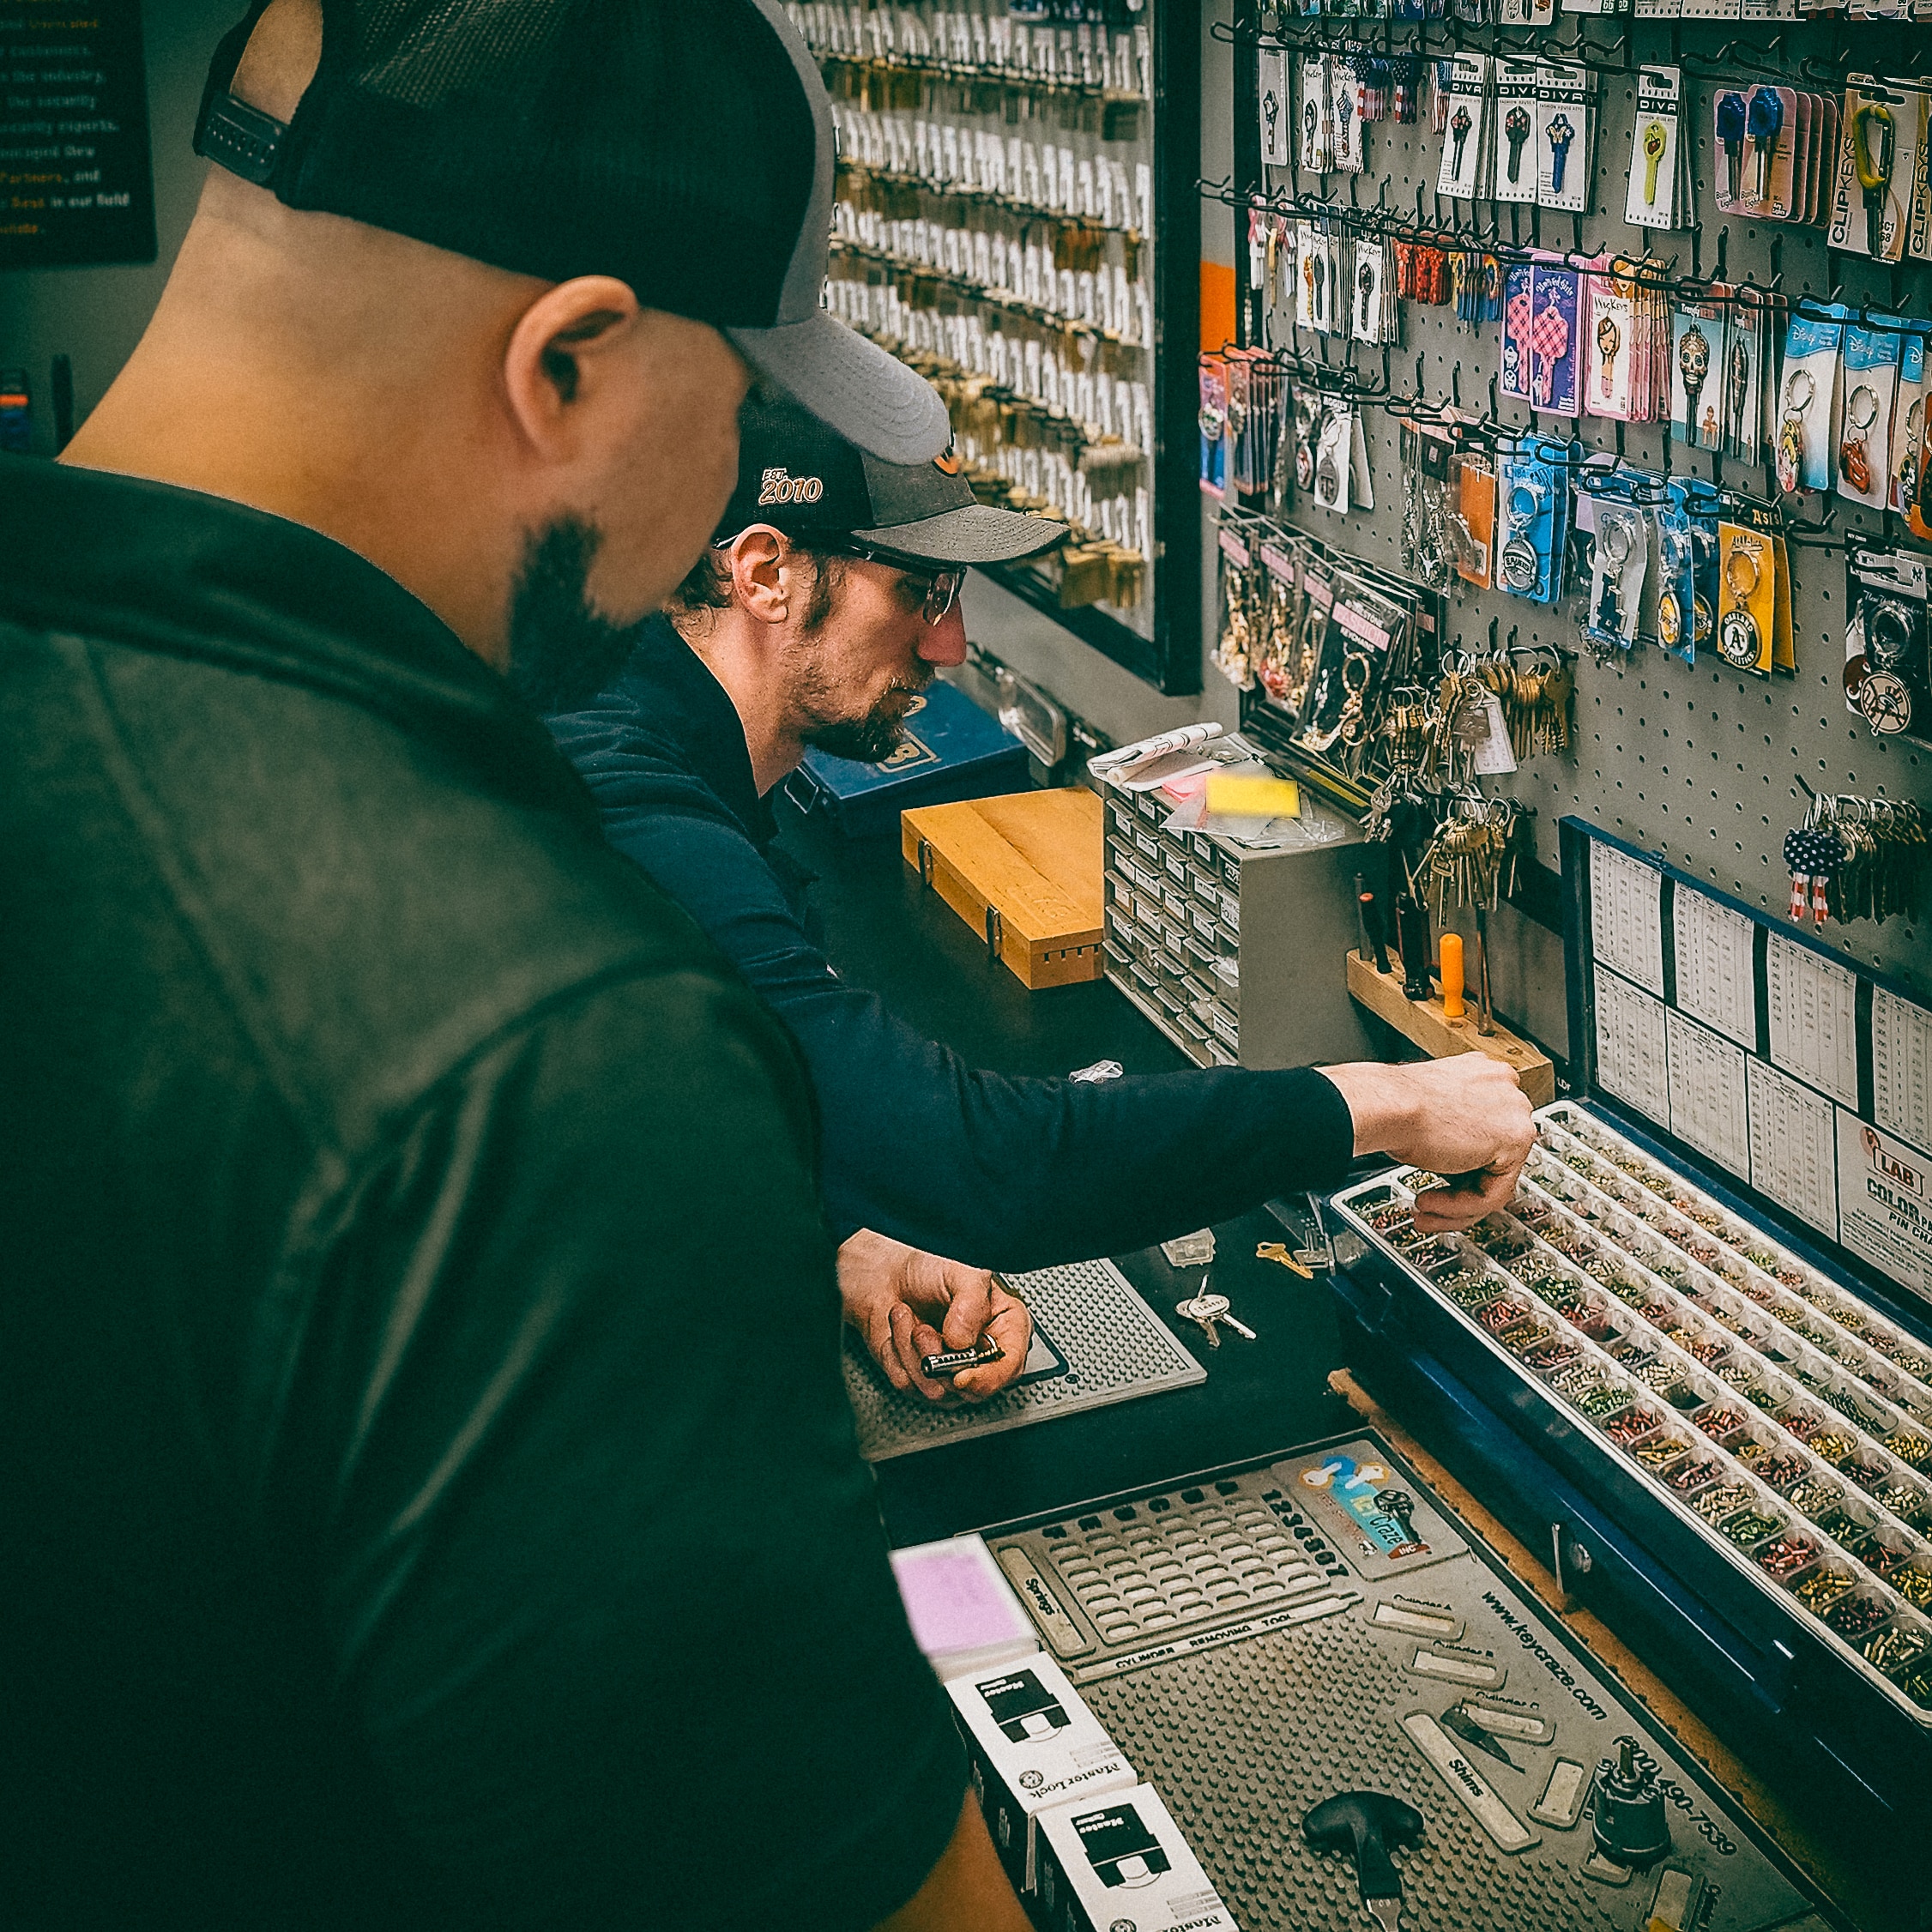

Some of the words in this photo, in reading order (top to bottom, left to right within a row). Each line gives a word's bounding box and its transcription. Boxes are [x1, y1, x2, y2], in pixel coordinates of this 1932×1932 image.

[1452, 83, 1482, 94] DIVA
[1539, 90, 1583, 101] DIVA
[1639, 100, 1676, 112] DIVA
[758, 477, 824, 506] 2010
[1881, 1154, 1914, 1187] LAB
[1867, 1177, 1920, 1225] COLOR
[1889, 1211, 1909, 1230] PIN
[1370, 1515, 1404, 1544] Craze
[1398, 1545, 1417, 1556] INC
[1024, 1578, 1060, 1616] Springs
[1115, 1645, 1175, 1669] CYLINDER
[1189, 1624, 1253, 1648] REMOVING
[1261, 1613, 1295, 1628] TOOL
[1481, 1591, 1608, 1721] www.keycraze.com
[1448, 1759, 1483, 1797] Shims
